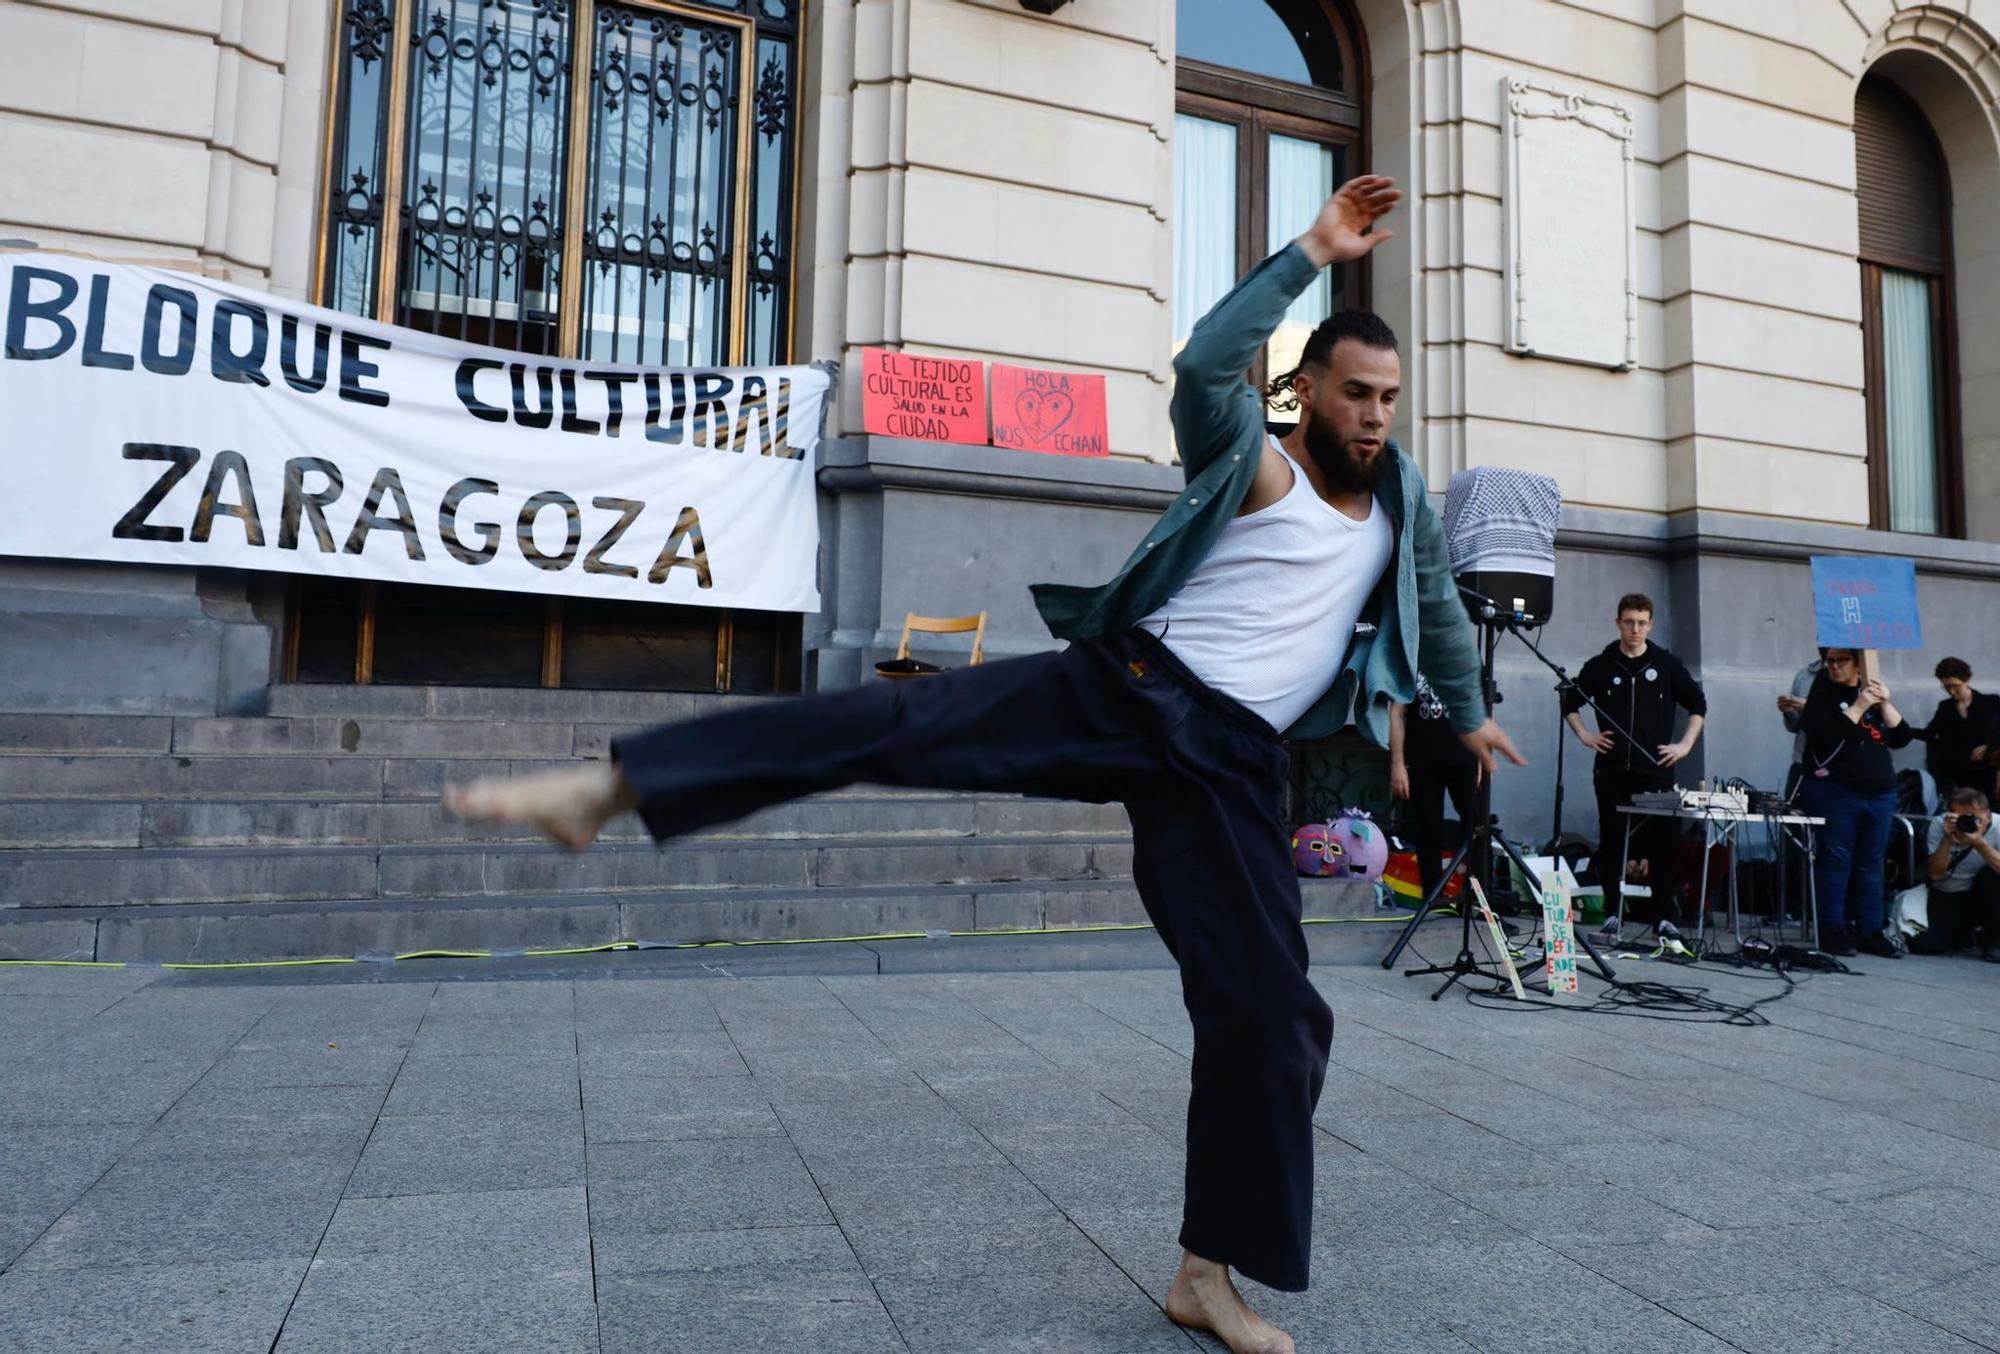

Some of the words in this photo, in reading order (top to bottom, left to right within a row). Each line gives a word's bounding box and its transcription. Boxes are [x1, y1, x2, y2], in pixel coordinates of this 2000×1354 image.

[4, 265, 392, 407] BLOQUE
[454, 356, 806, 461] CULTURAL
[881, 354, 902, 376] EL
[909, 357, 971, 384] TEJIDO
[867, 373, 951, 401] CULTURAL
[955, 386, 973, 403] ES
[892, 396, 926, 414] SALUD
[931, 403, 946, 415] EN
[951, 406, 970, 418] LA
[886, 413, 950, 441] CIUDAD
[994, 424, 1024, 447] NOS
[1054, 432, 1102, 453] ECHAN
[111, 442, 713, 589] ZARAGOZA
